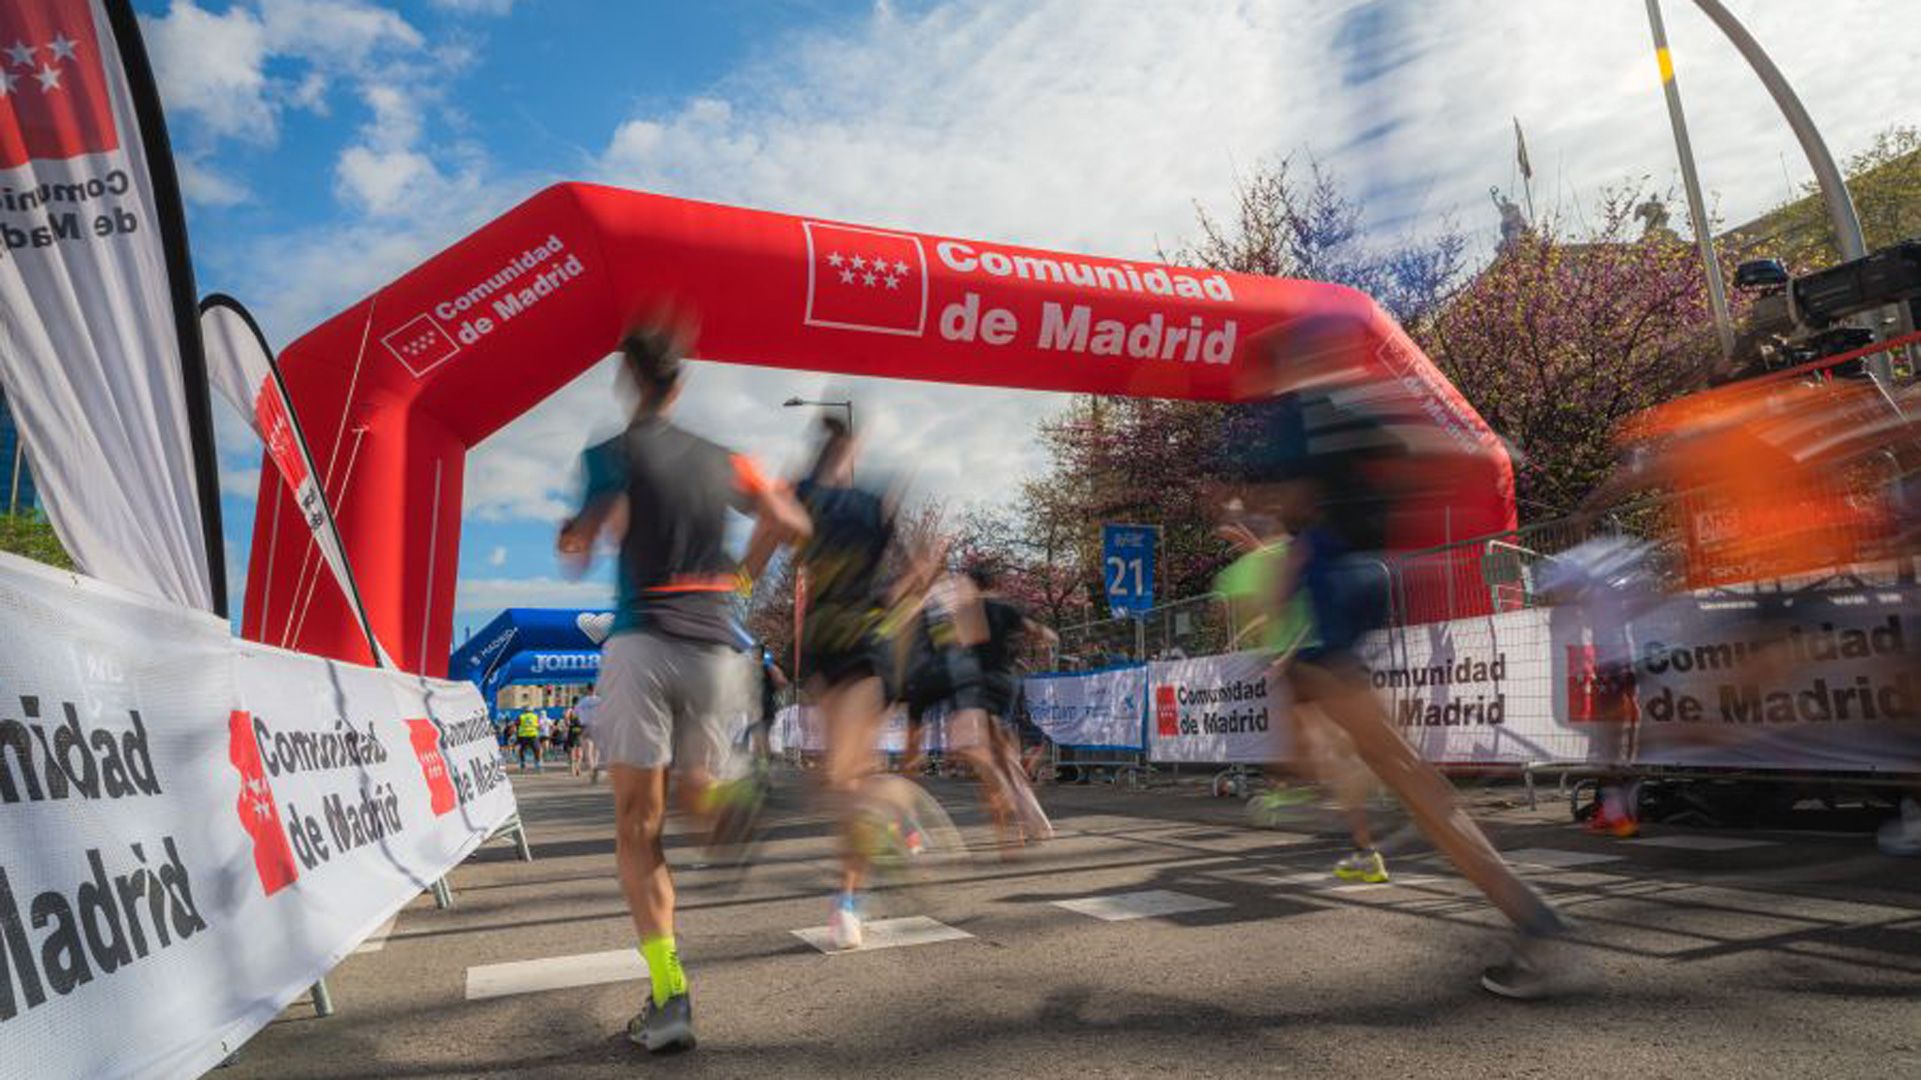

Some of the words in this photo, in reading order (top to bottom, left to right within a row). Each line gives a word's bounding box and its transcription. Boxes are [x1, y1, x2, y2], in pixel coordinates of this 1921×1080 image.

[435, 234, 564, 320] Comunidad
[458, 316, 495, 345] de
[492, 254, 584, 321] Madrid
[936, 241, 1234, 301] Comunidad
[939, 293, 1018, 345] de
[1038, 301, 1237, 364] Madrid
[1107, 556, 1143, 596] 21
[1372, 653, 1506, 688] omunidad
[1645, 615, 1904, 674] Comuidad
[1178, 677, 1267, 705] Comunidad
[1397, 694, 1505, 726] Madrid
[1646, 686, 1703, 722] de
[1718, 674, 1917, 724] Madrid
[254, 716, 388, 777] Comunidad
[1180, 714, 1199, 735] de
[1203, 707, 1269, 735] Madrid
[288, 803, 330, 870] de
[323, 782, 403, 853] Madrid
